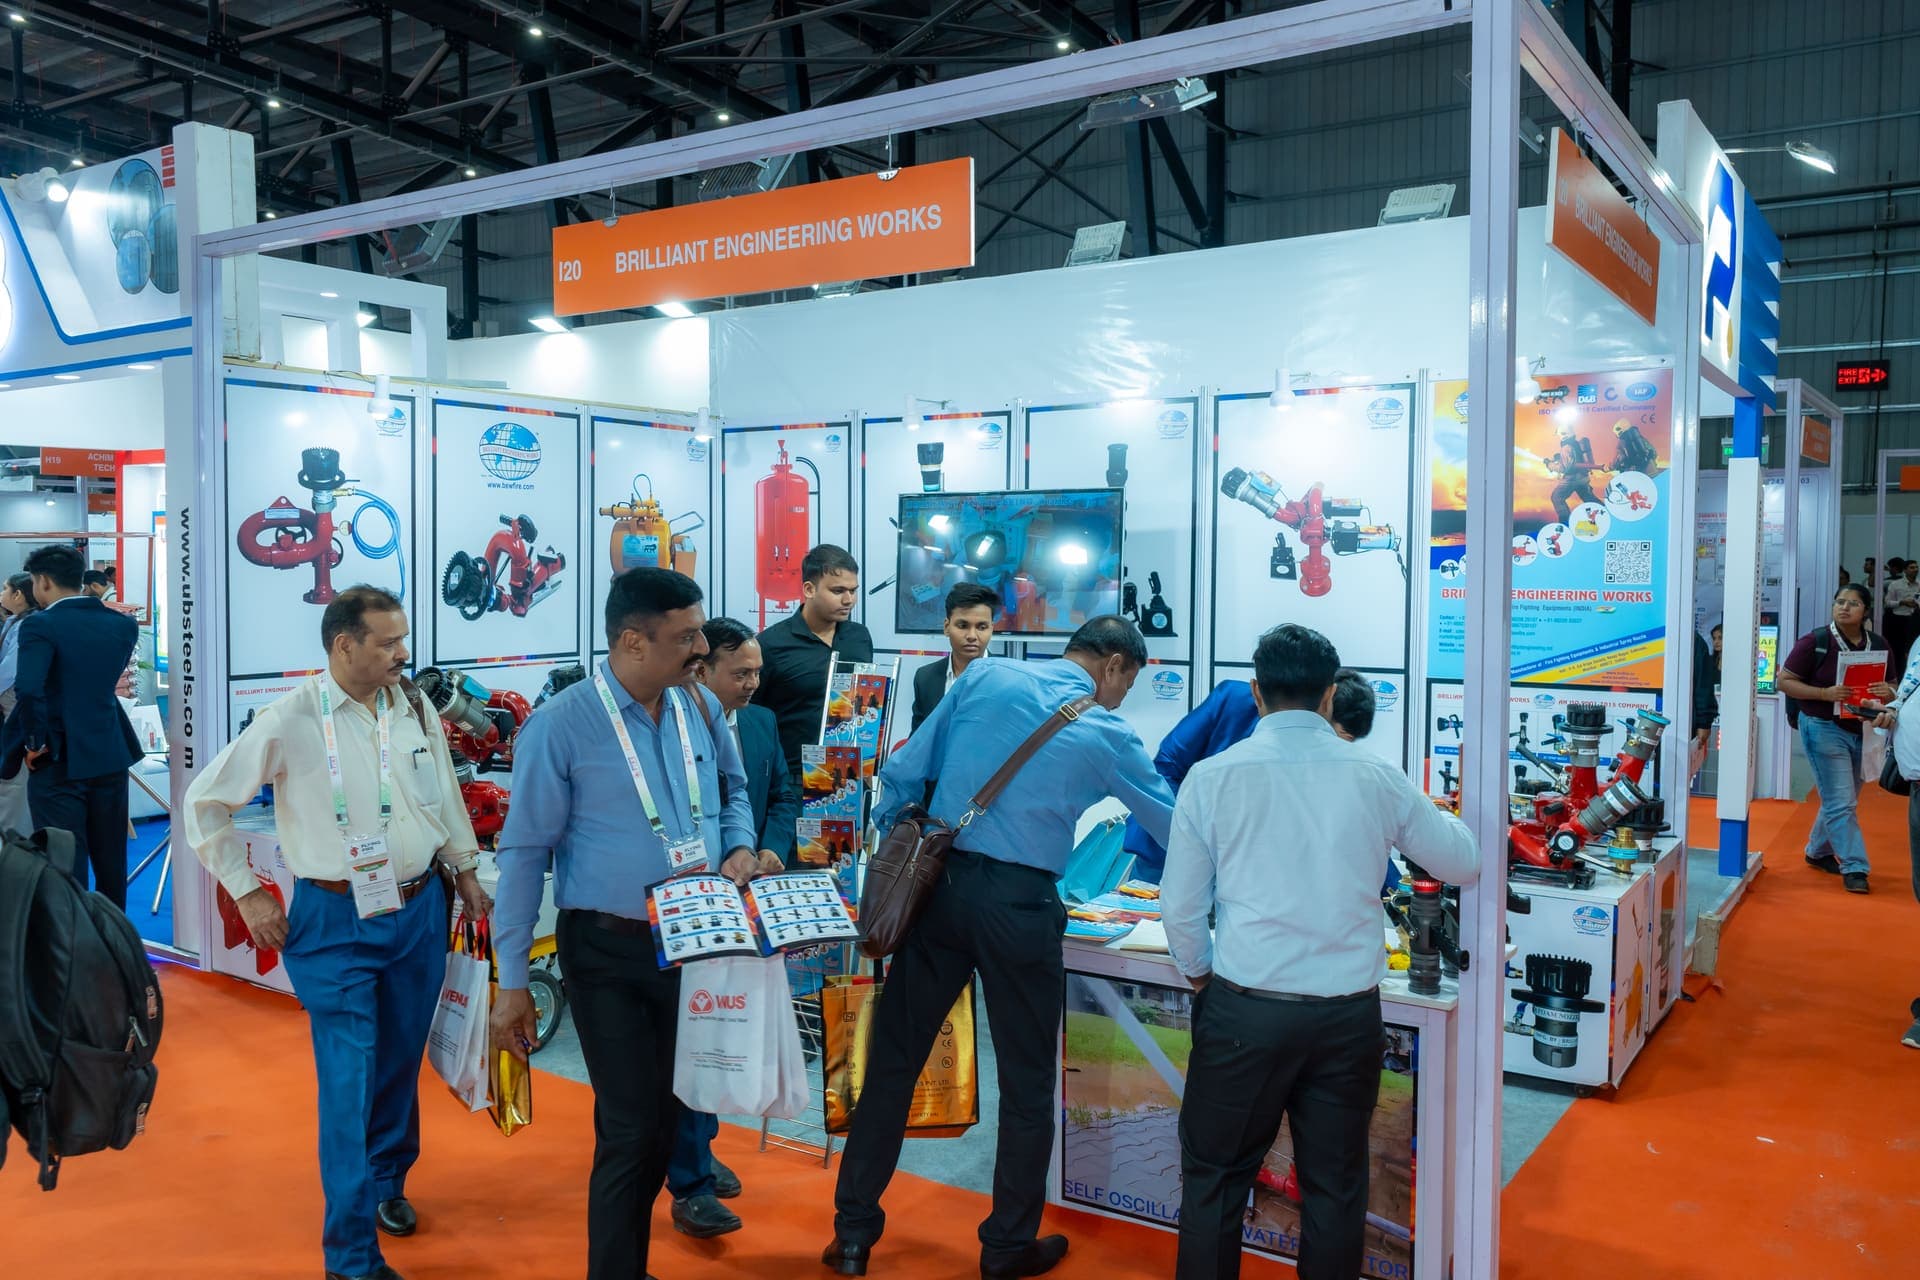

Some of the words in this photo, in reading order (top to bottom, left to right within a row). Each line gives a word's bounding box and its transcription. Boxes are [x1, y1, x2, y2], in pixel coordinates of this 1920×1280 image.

[558, 259, 582, 282] I20
[615, 239, 708, 273] BRILLIANT
[713, 217, 852, 260] ENGINEERING
[857, 204, 942, 239] WORKS
[1838, 368, 1858, 376] FIRE
[1838, 376, 1858, 385] EXIT
[45, 455, 61, 464] H19
[1511, 589, 1597, 602] ENGINEERING
[1602, 591, 1652, 603] WORKS
[1618, 702, 1649, 710] COMPANY
[715, 994, 745, 1010] WUS
[1064, 1179, 1104, 1201] SELF
